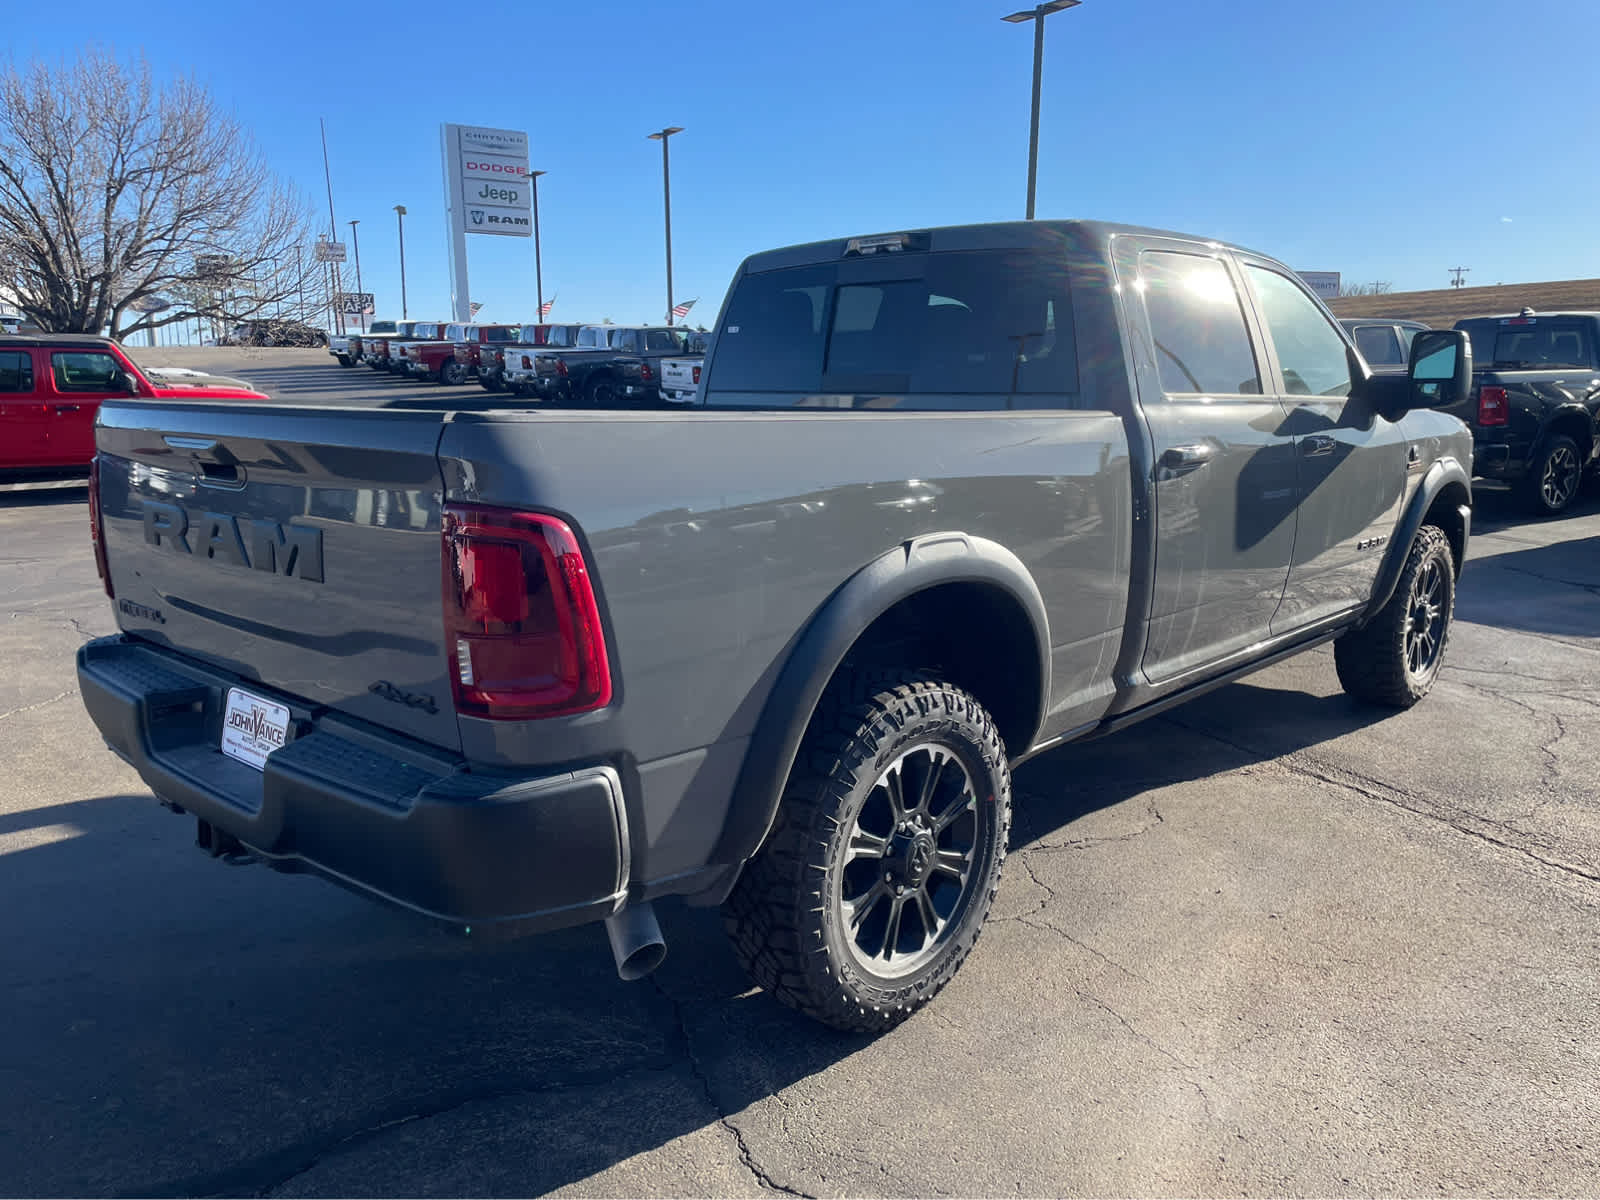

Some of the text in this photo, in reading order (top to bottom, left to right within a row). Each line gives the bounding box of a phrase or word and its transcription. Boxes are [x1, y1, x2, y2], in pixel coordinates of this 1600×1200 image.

[465, 132, 524, 143] CHRYSLER
[466, 162, 527, 175] DODGE
[478, 184, 518, 204] Jeep
[487, 215, 529, 225] RAM
[143, 501, 325, 584] RAM
[229, 711, 254, 733] JOHN
